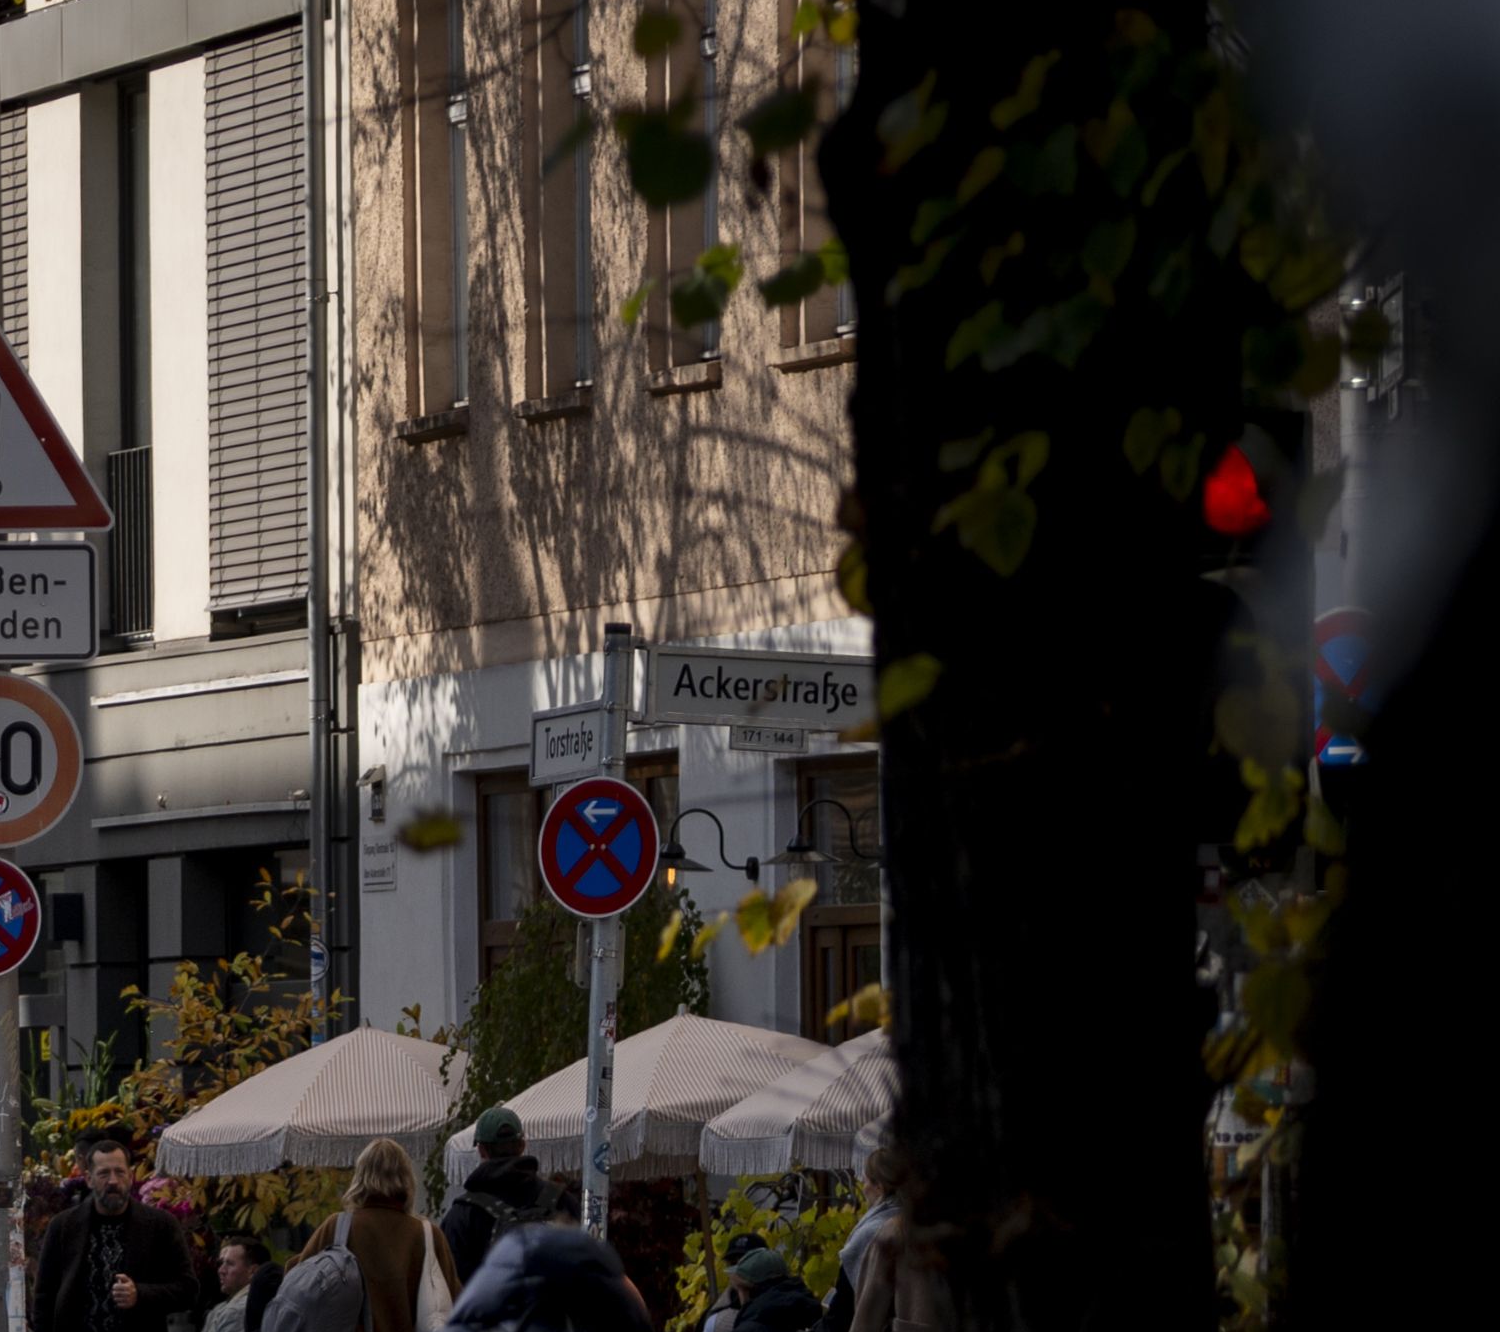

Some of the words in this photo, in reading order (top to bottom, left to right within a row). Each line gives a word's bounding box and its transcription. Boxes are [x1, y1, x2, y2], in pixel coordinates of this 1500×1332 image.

[673, 663, 859, 714] Ackerstraße
[544, 720, 594, 761] Torstraße
[742, 730, 762, 742] 171
[774, 732, 794, 744] 144
